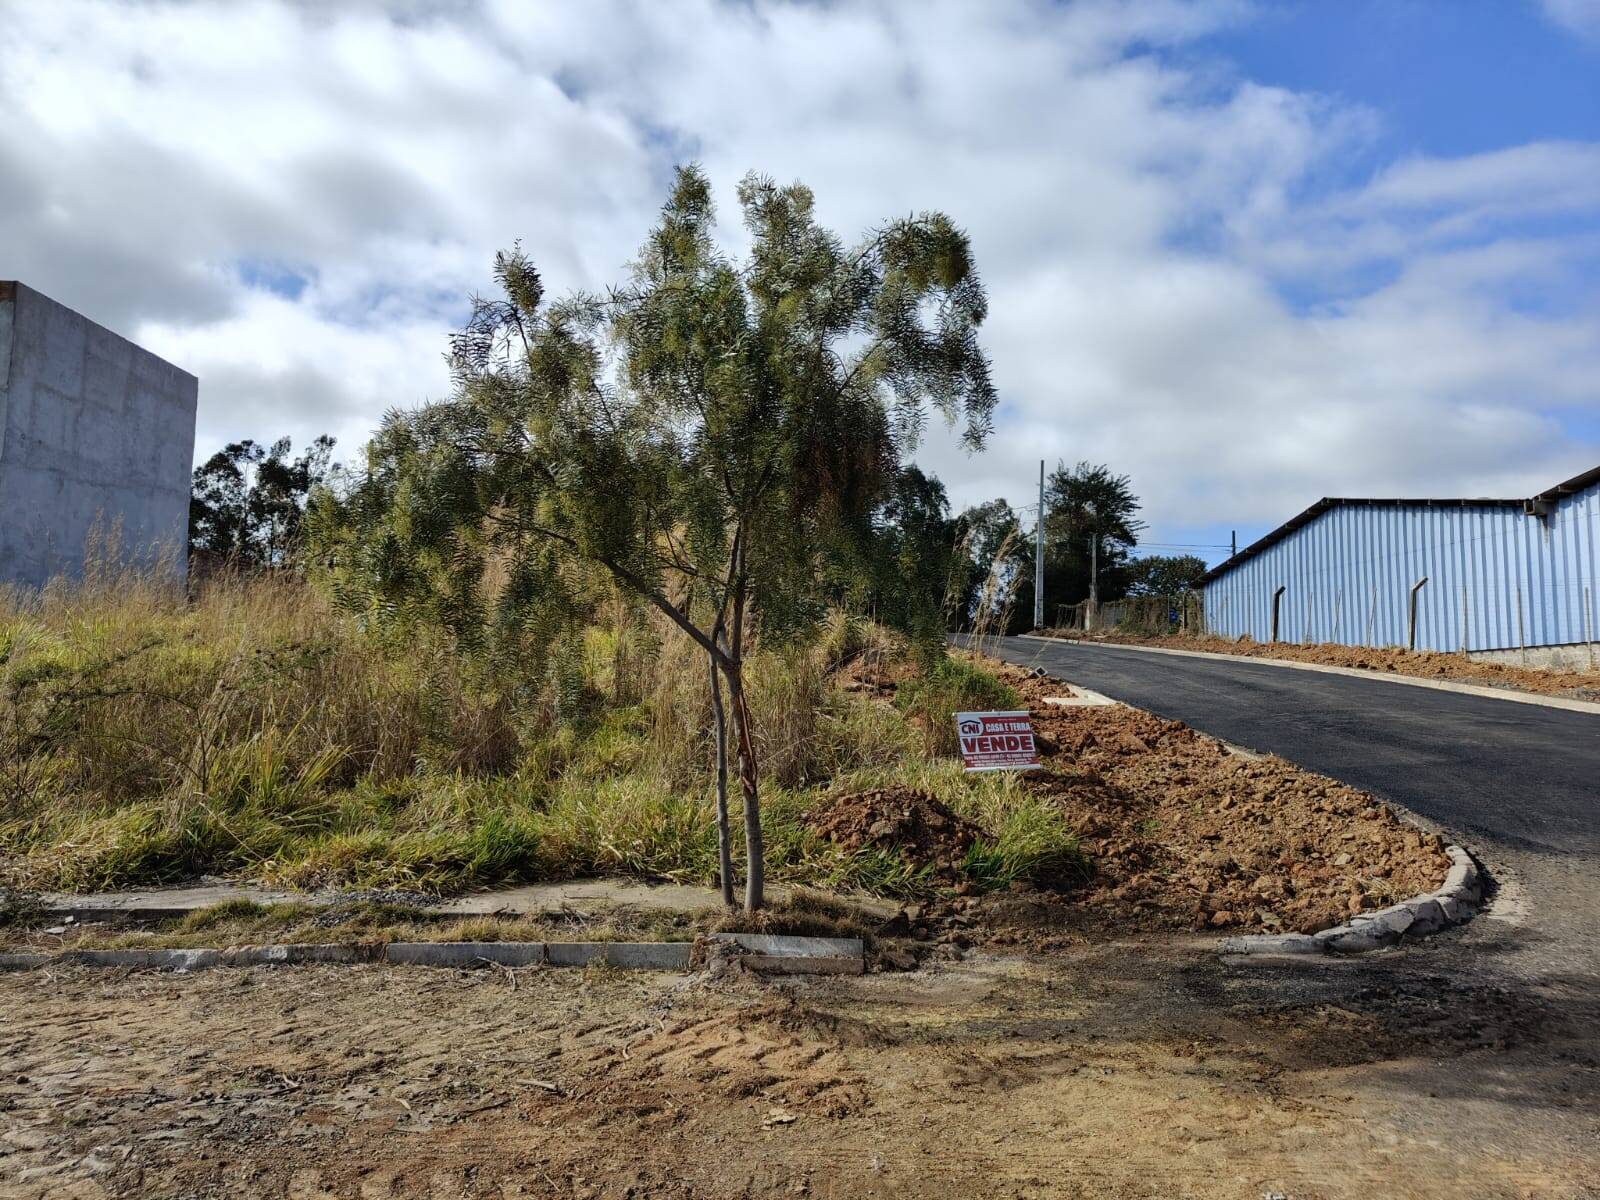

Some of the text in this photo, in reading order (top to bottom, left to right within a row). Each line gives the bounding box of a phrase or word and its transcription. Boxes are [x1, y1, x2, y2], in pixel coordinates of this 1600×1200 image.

[985, 723, 1004, 733] CASA
[1005, 723, 1009, 732] E
[962, 735, 1034, 752] VENDE
